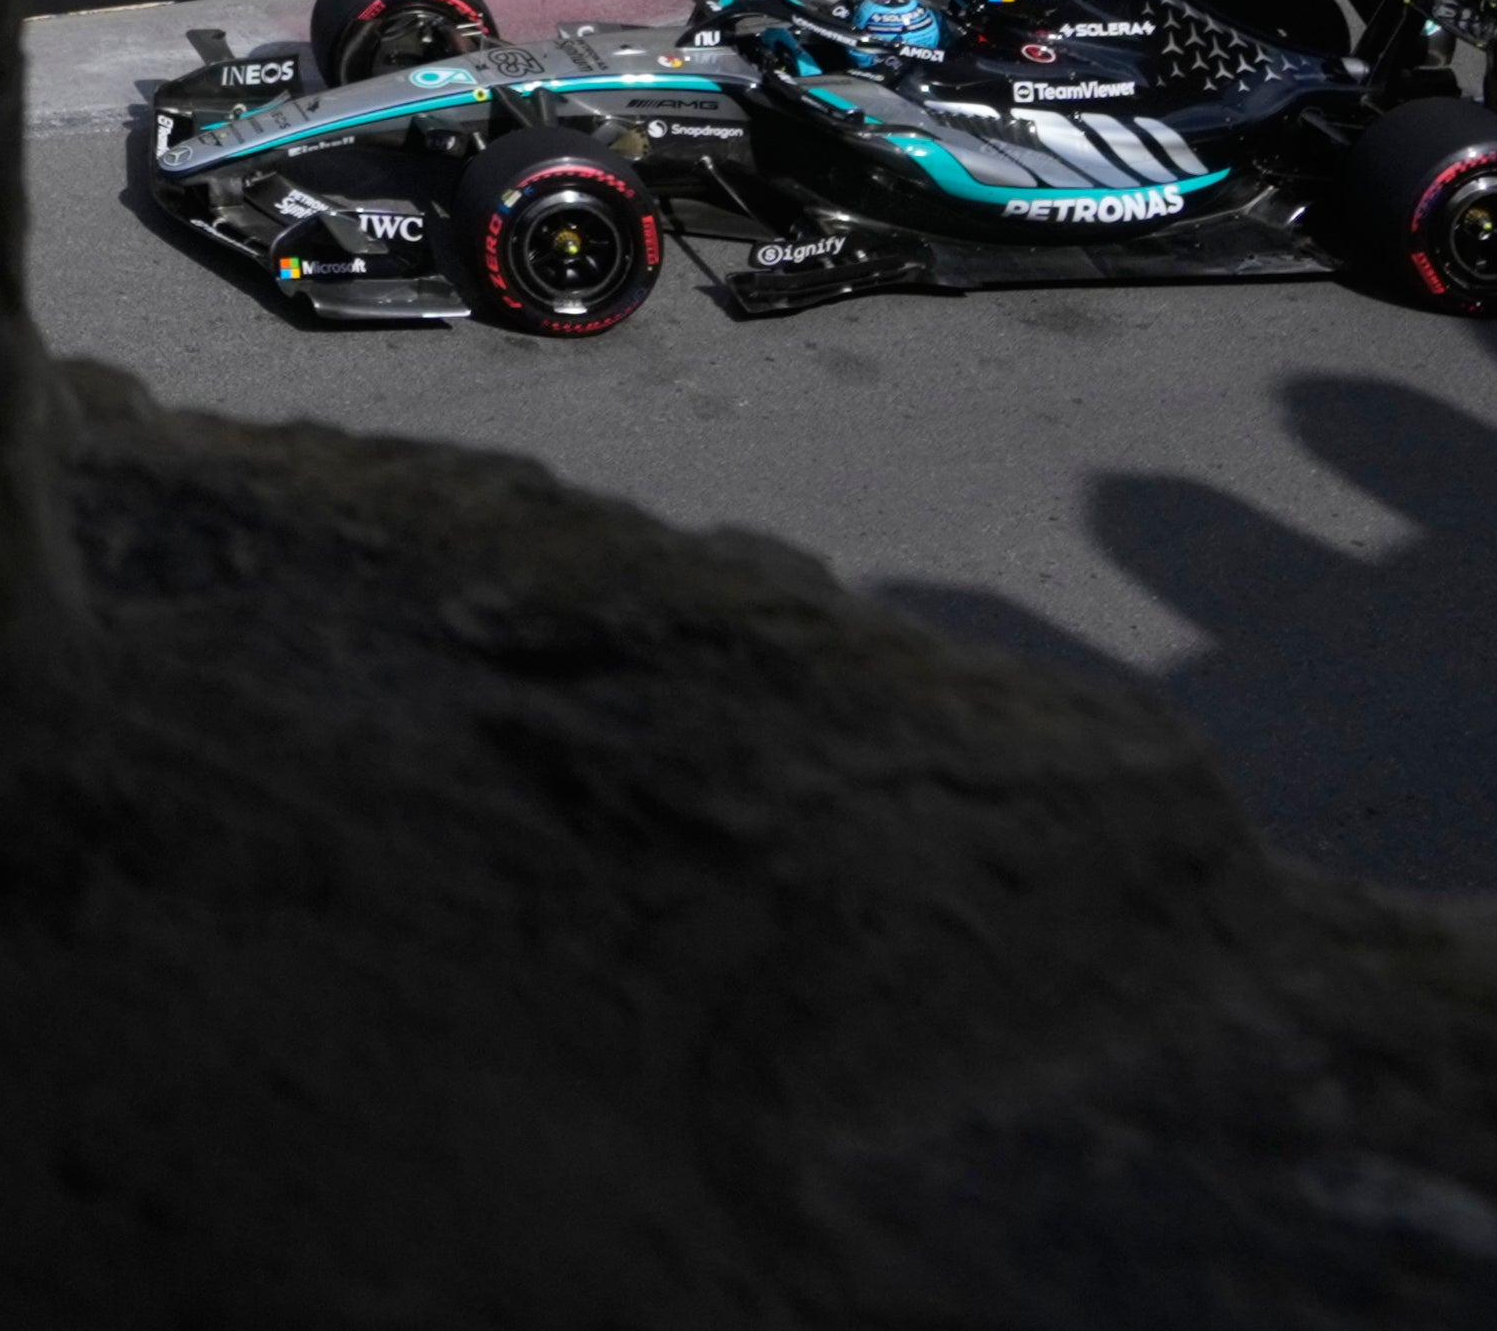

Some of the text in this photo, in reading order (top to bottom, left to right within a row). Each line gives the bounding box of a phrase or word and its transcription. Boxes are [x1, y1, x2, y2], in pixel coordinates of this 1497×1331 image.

[1073, 21, 1143, 37] SOLERA
[220, 60, 295, 87] INEOS
[1034, 80, 1136, 101] TeamViewer
[656, 99, 720, 111] AMG
[671, 123, 744, 139] Snapdragon
[1001, 184, 1185, 224] PETRONAS
[358, 213, 424, 242] IWC
[302, 257, 368, 275] Microsoft
